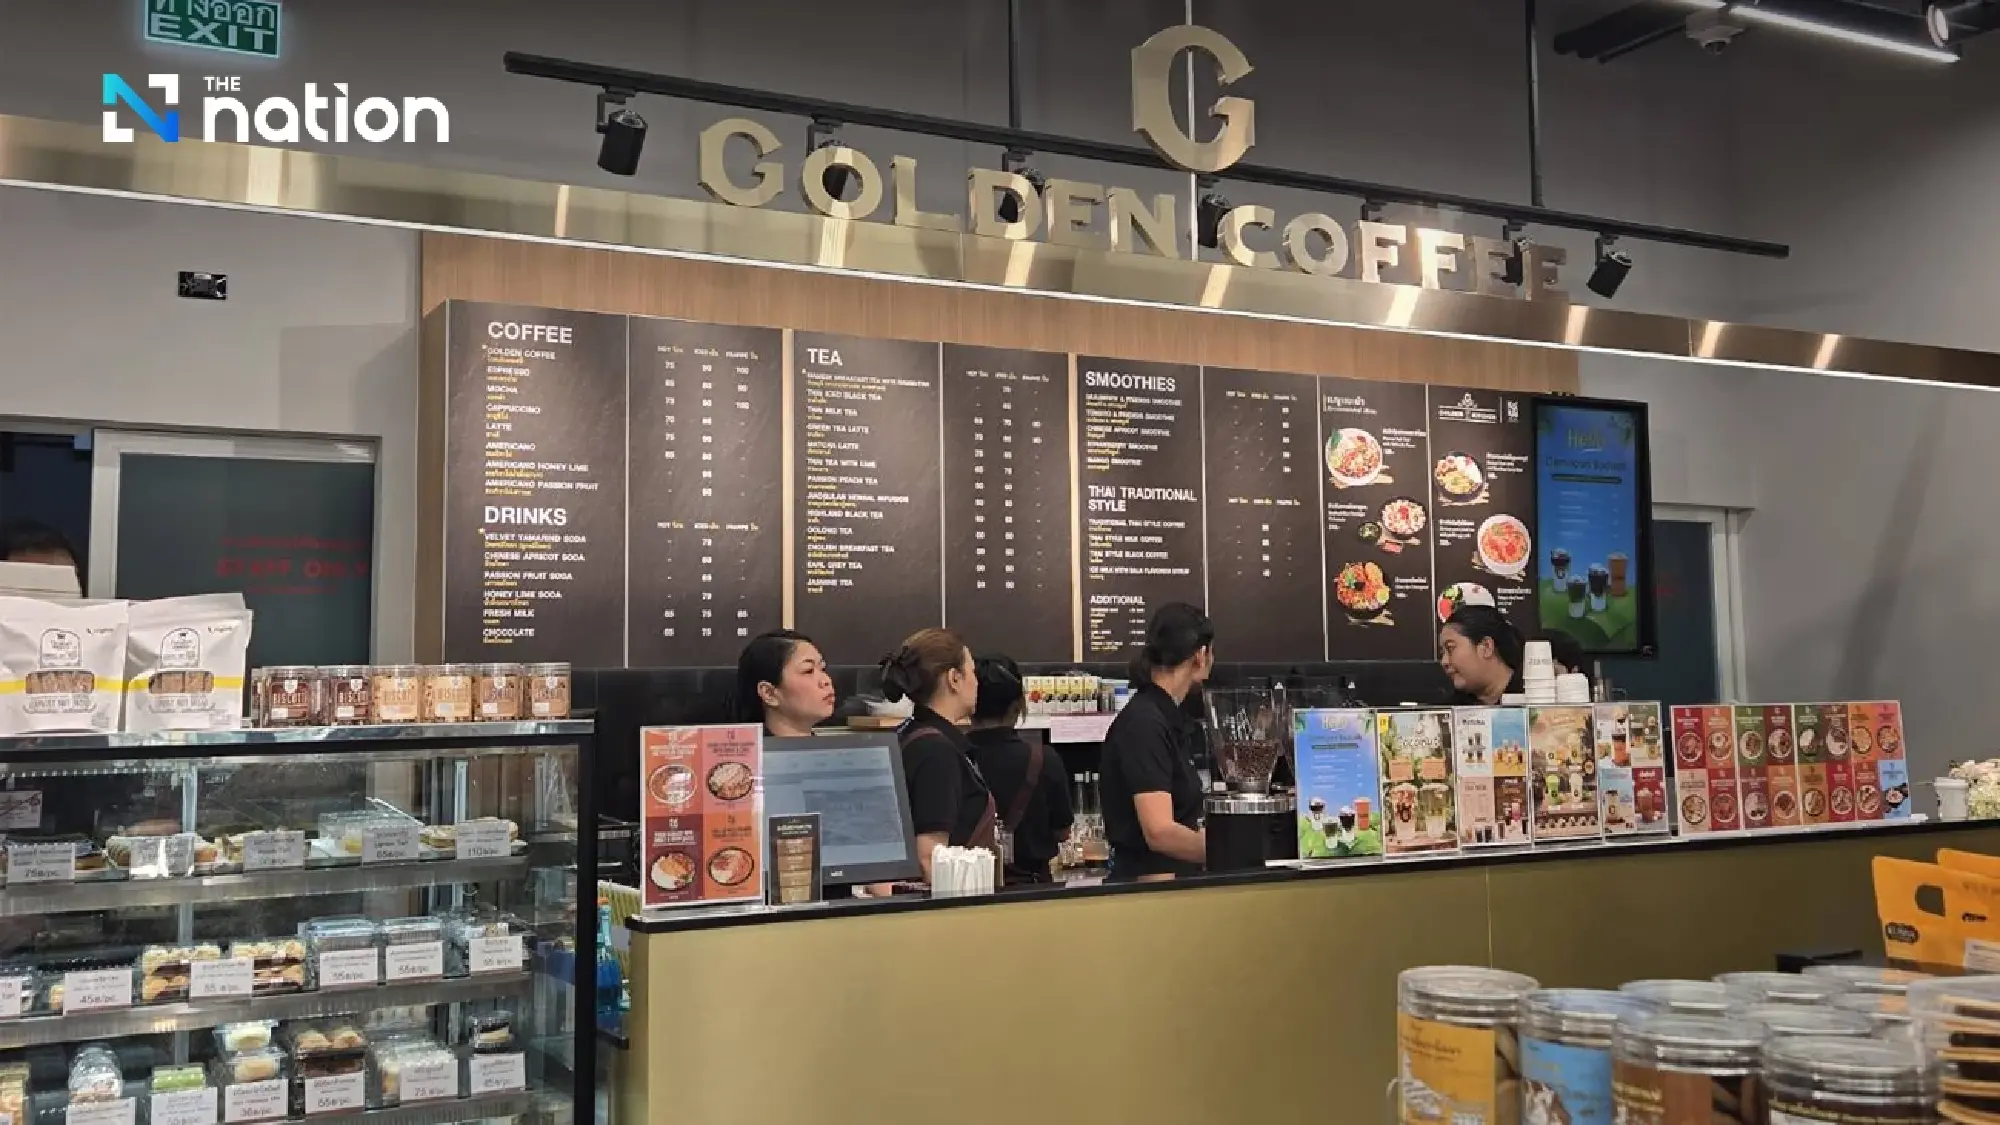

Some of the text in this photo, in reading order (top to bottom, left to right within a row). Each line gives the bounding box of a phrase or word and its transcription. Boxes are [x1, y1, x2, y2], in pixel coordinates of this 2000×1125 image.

[151, 12, 274, 50] EXIT
[1131, 25, 1255, 172] G
[699, 118, 1570, 302] GOLDEN COFFEE
[487, 321, 573, 344] COFFEE
[525, 349, 555, 360] COFFEE
[807, 348, 843, 366] TEA
[1085, 371, 1176, 392] SMOOTHIES
[487, 385, 518, 394] MOCHA
[844, 391, 867, 400] BLACK
[868, 392, 882, 400] TEA
[486, 403, 541, 414] CAPPUCCINO
[485, 422, 512, 431] LATTE
[833, 424, 846, 432] TEA
[848, 425, 869, 434] LATTE
[485, 441, 535, 450] AMERICANO
[838, 442, 859, 450] LATTE
[485, 460, 588, 472] AMERICANO HONEY LIME
[825, 459, 838, 467] TEA
[485, 479, 599, 491] AMERICANO PASSION FRUIT
[807, 475, 878, 485] PASSION PEACH TEA
[1088, 485, 1197, 501] THAI TRADITIONAL
[1088, 500, 1126, 511] STYLE
[484, 506, 567, 526] DRINKS
[484, 534, 515, 542] VELVET
[563, 535, 586, 543] SODA
[484, 552, 585, 562] CHINESE APRICOT SODA
[484, 571, 573, 580] PASSION FRUIT SODA
[484, 590, 562, 599] HONEY LIME SODA
[1091, 595, 1145, 605] ADDITIONAL
[483, 609, 534, 617] FRESH MILK
[483, 628, 535, 636] CHOCOLATE
